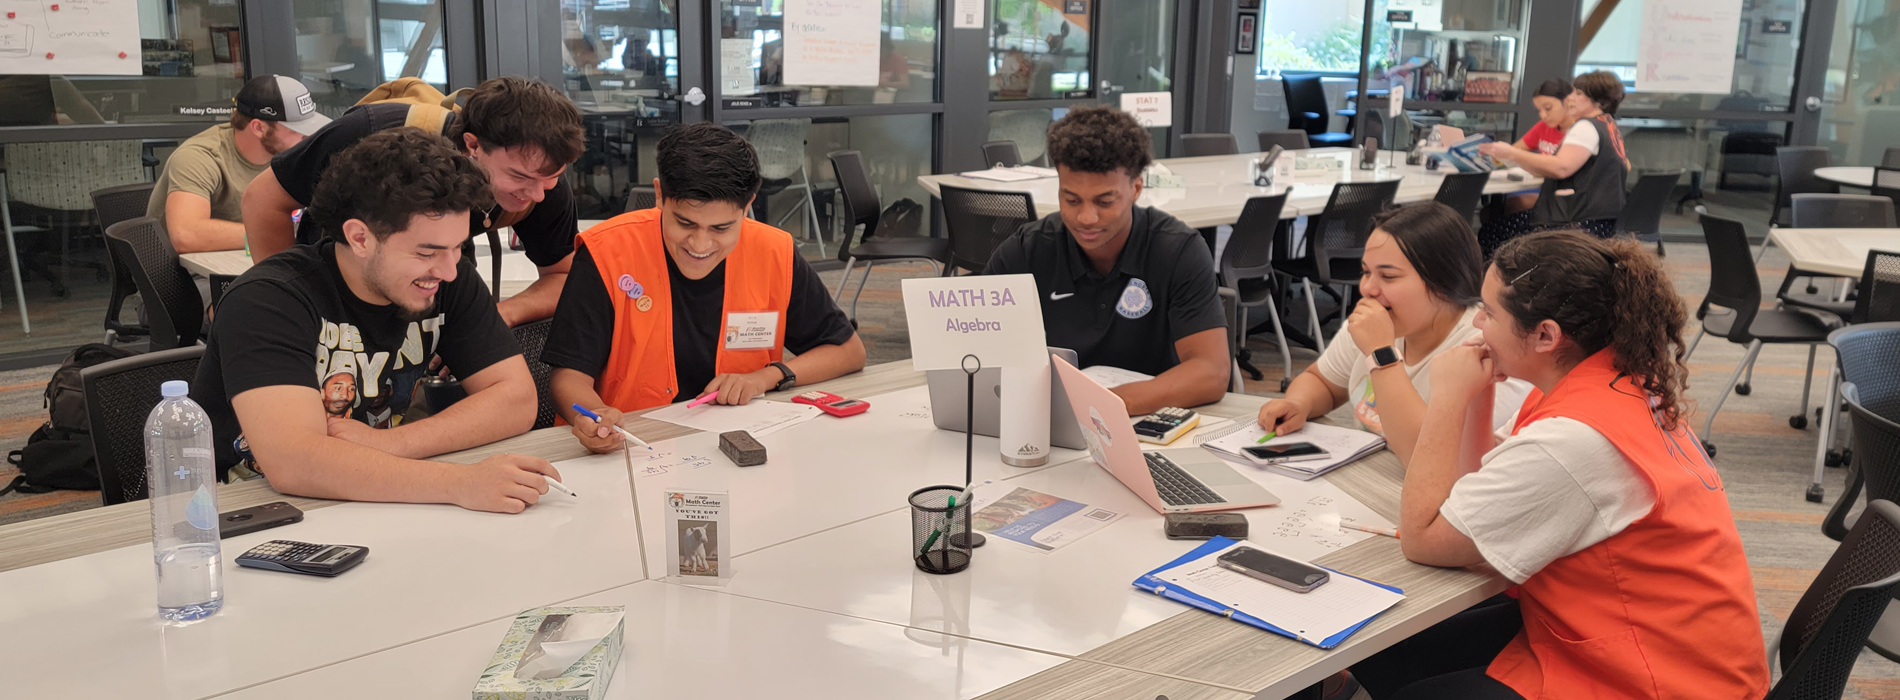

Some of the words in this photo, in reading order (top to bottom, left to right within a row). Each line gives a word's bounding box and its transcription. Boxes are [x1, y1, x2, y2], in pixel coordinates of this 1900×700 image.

[48, 29, 110, 39] Communicate
[180, 107, 204, 115] Kelsey
[929, 289, 985, 308] MATH
[991, 288, 1016, 306] 3A
[946, 318, 1001, 333] Algebra
